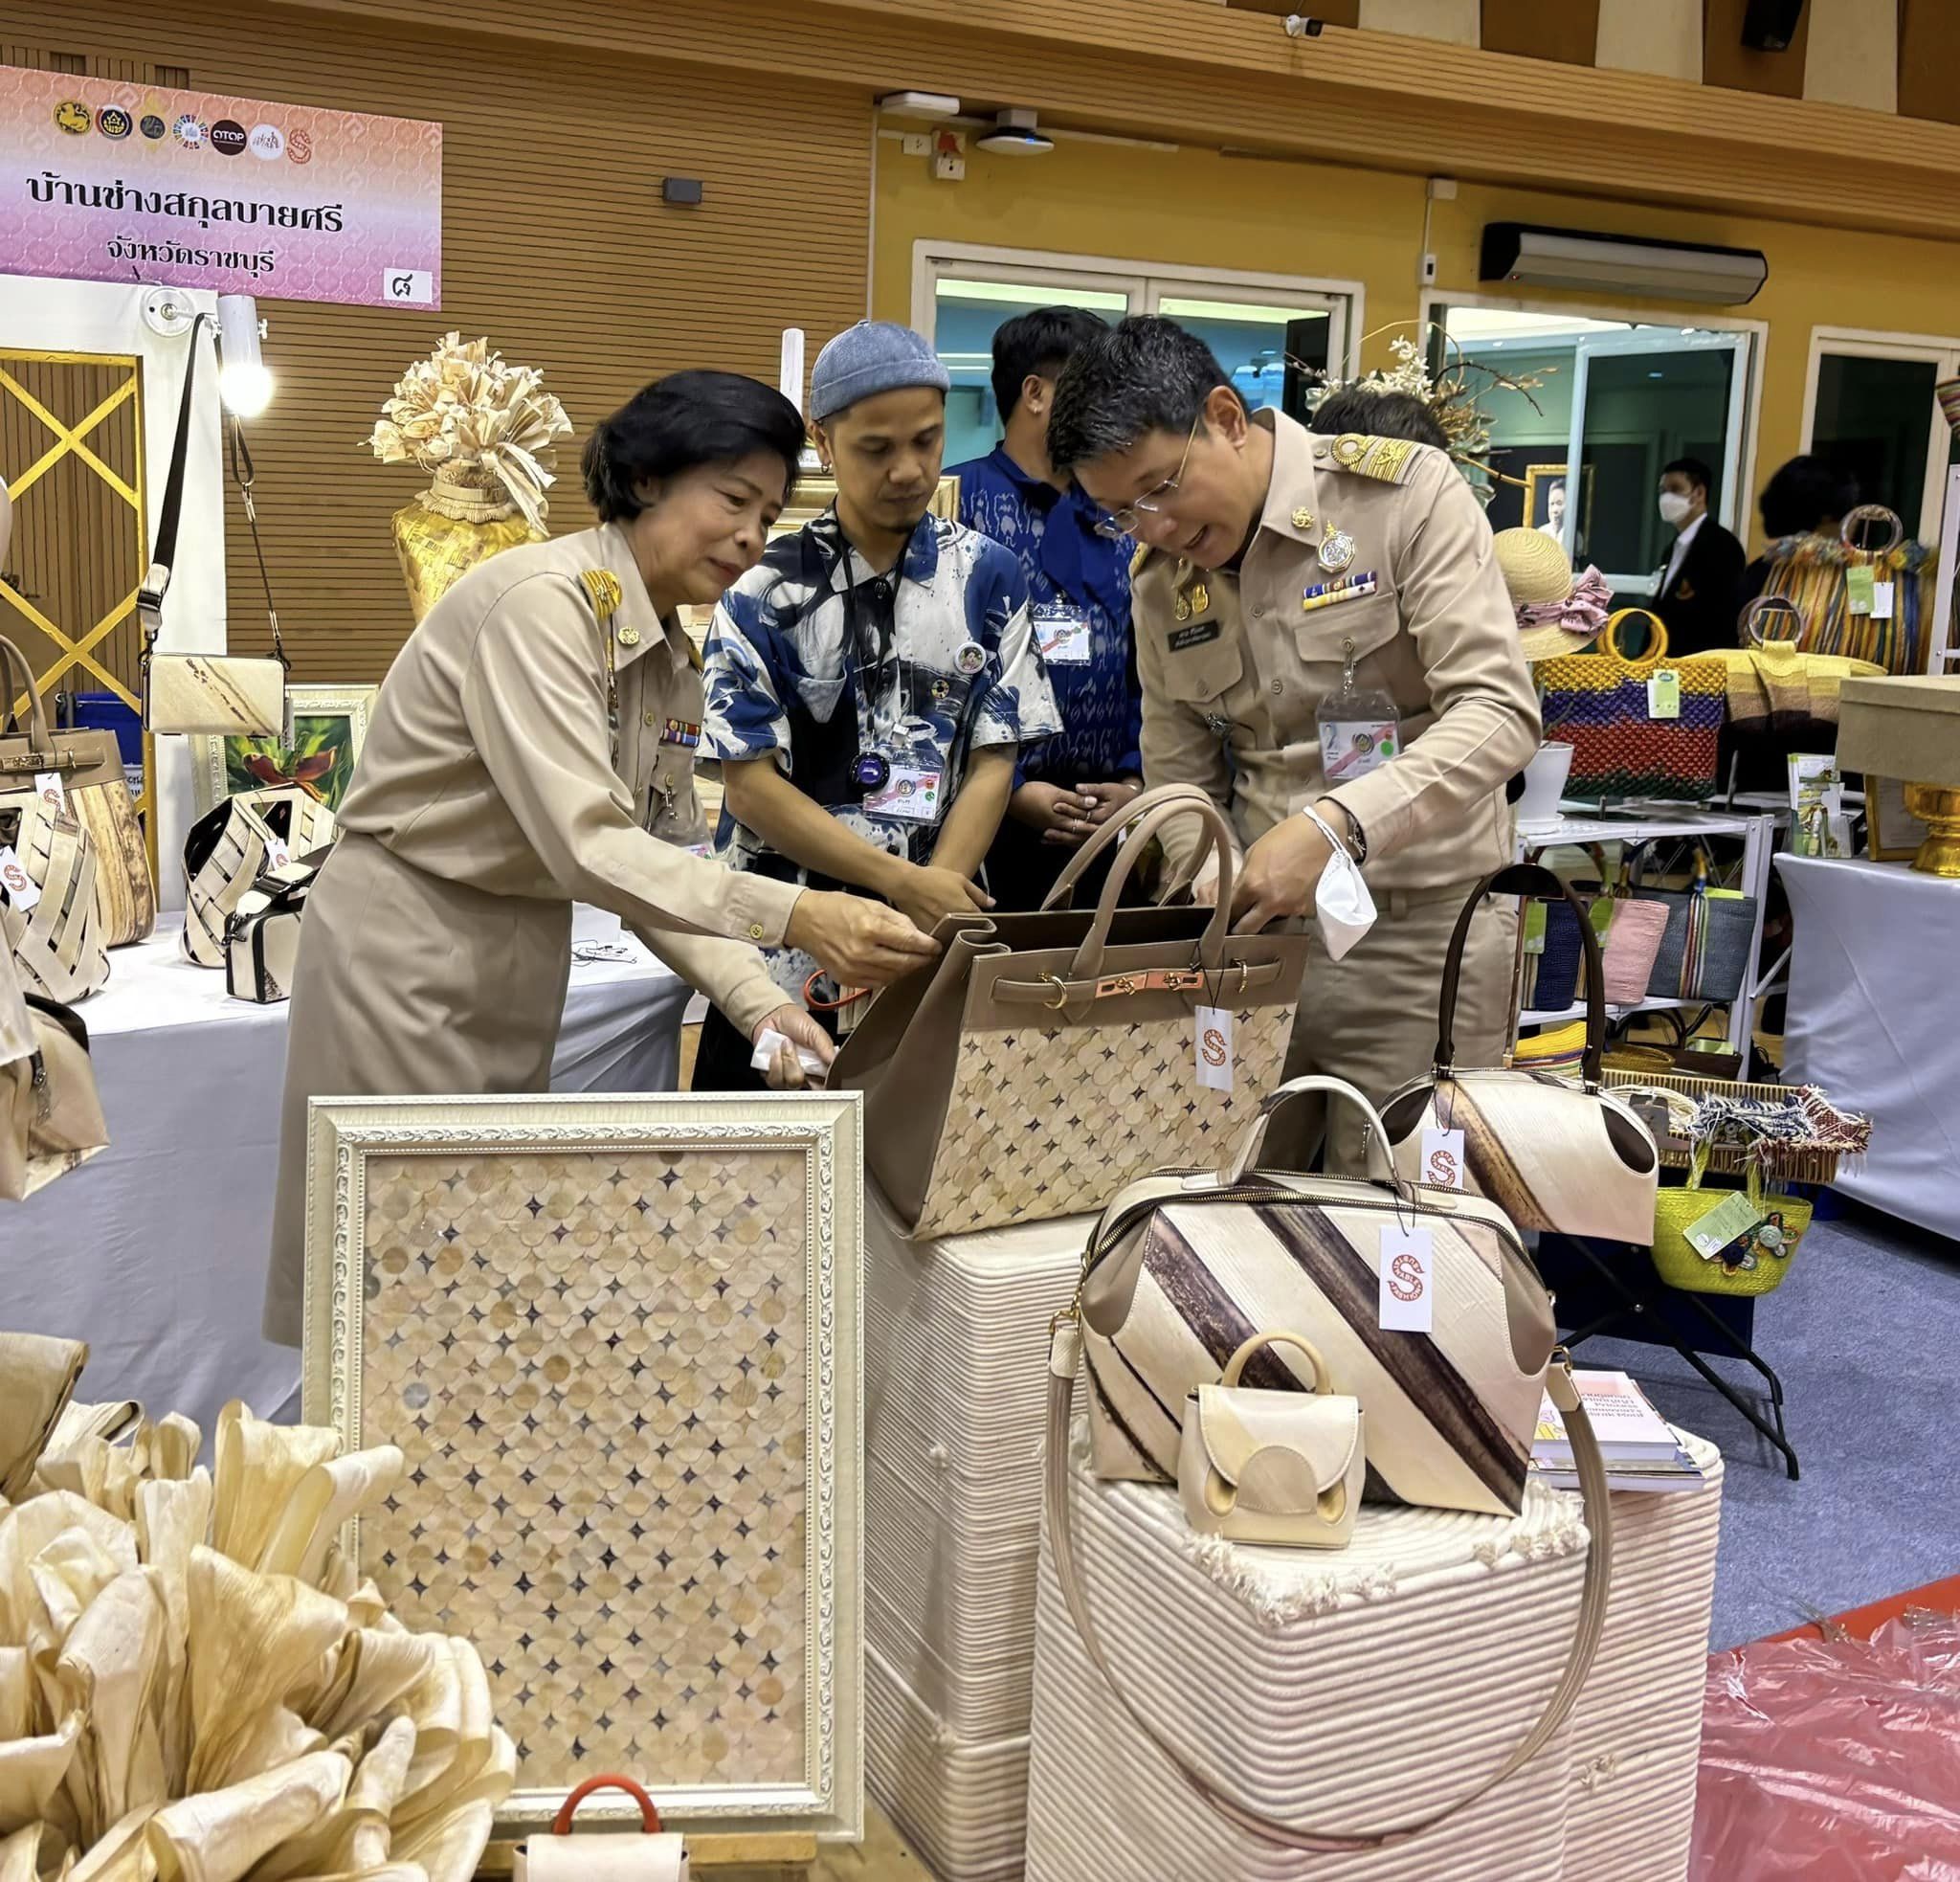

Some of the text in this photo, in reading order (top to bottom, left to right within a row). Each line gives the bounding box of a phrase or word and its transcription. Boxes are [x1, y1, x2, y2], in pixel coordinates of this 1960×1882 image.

[26, 170, 344, 233] บ้านช่างสกุลบายศรี
[106, 235, 275, 279] จังหวัดราชบุรี
